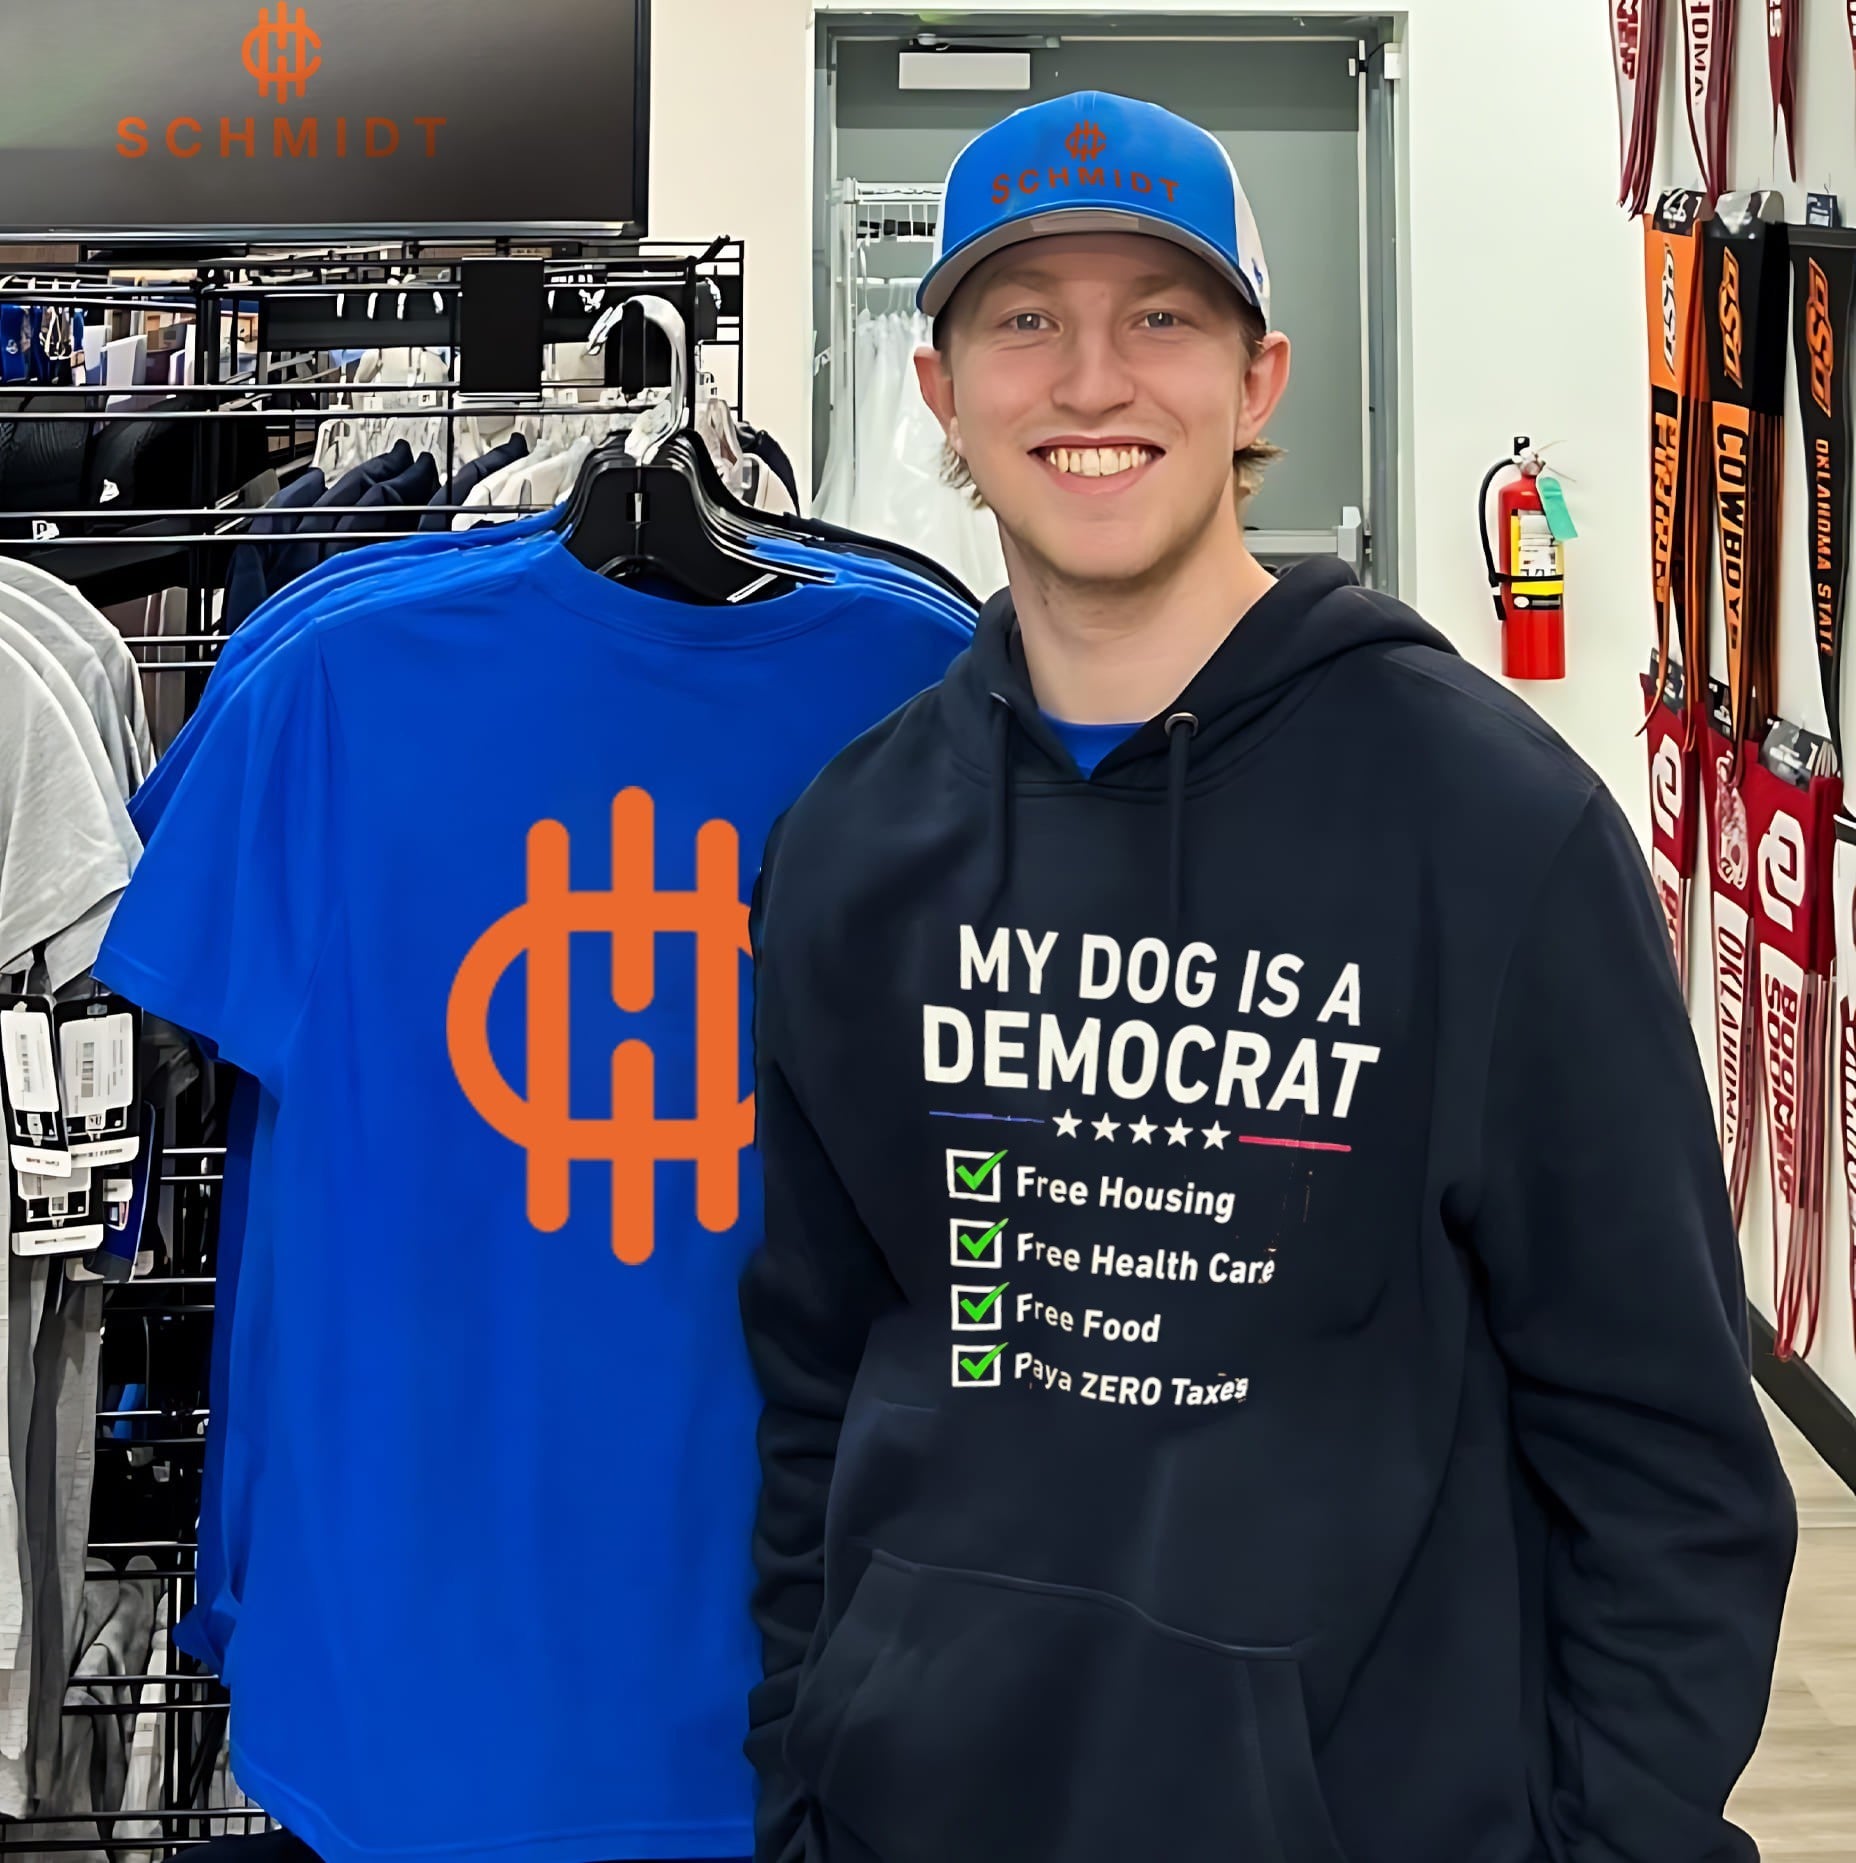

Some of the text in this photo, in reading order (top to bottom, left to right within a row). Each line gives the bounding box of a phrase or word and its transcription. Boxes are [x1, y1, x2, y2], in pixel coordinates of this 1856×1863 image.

[116, 116, 448, 159] SCHMIDT
[992, 167, 1179, 205] SCHMIDT
[960, 925, 1360, 1026] MY DOG IS A
[923, 1005, 1380, 1118] DEMOCRAT
[1017, 1166, 1235, 1223] Free Housing
[1017, 1233, 1275, 1284] Free Health Care
[1017, 1293, 1161, 1342] Free Food
[1015, 1352, 1072, 1392] Paya
[1080, 1371, 1162, 1405] ZERO
